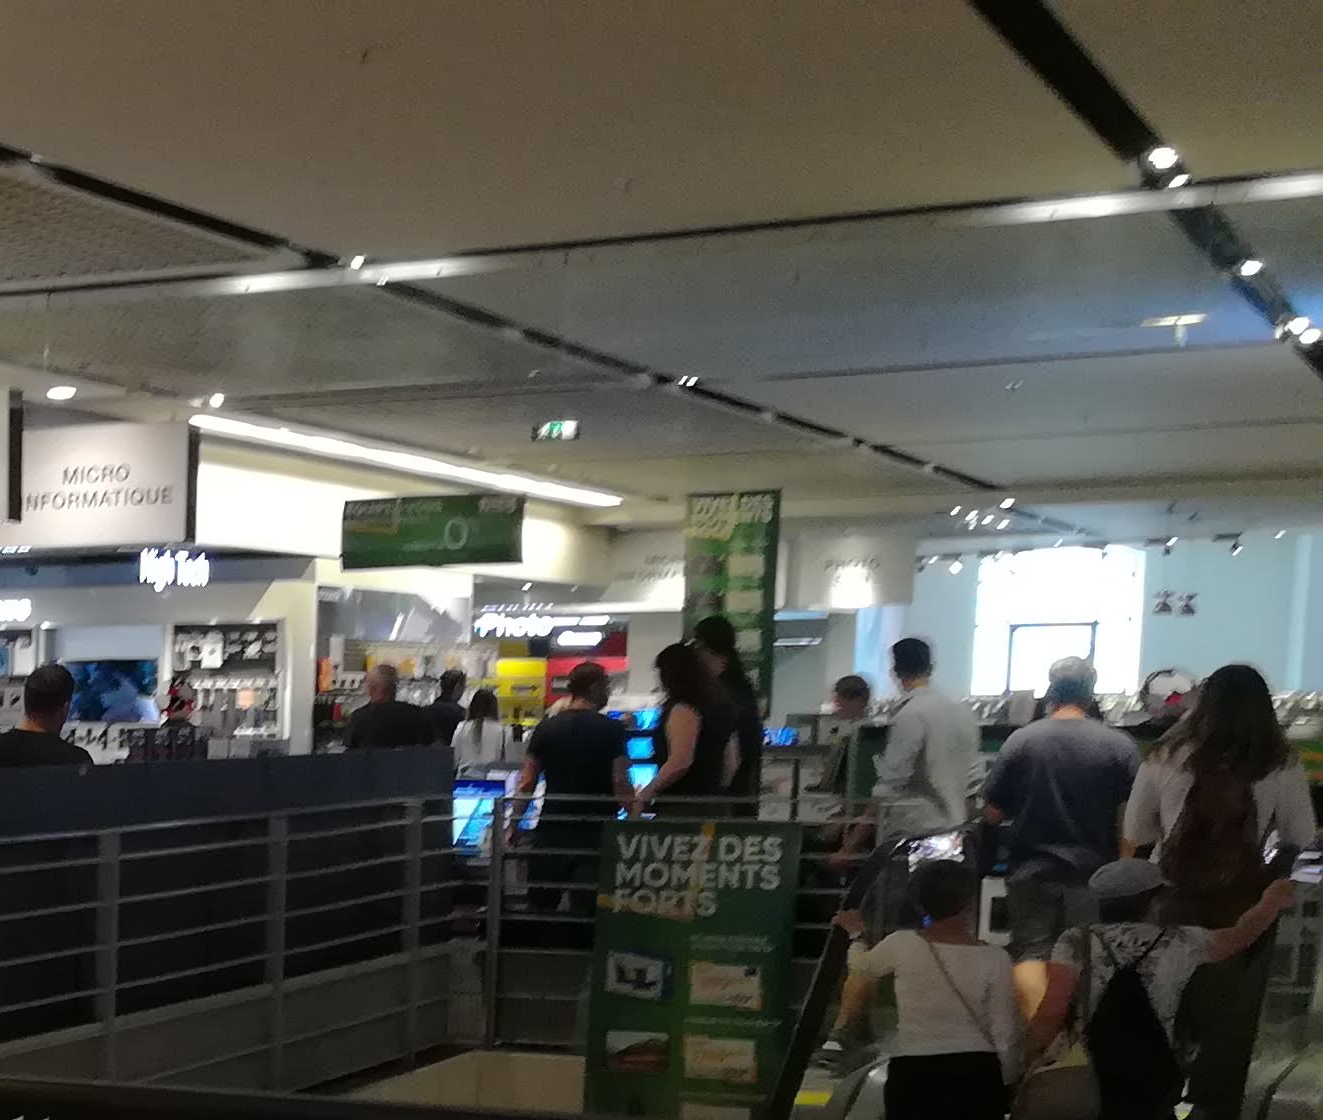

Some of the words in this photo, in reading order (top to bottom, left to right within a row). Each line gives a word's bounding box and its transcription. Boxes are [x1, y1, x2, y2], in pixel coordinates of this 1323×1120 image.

[62, 463, 132, 485] MICRO
[26, 486, 174, 513] NFORMATIQUE
[139, 547, 174, 592] High
[175, 549, 209, 588] Tech
[617, 834, 709, 864] VIVEZ
[718, 835, 783, 864] DES
[615, 859, 782, 891] MOMENTS
[613, 888, 718, 917] FORTS
